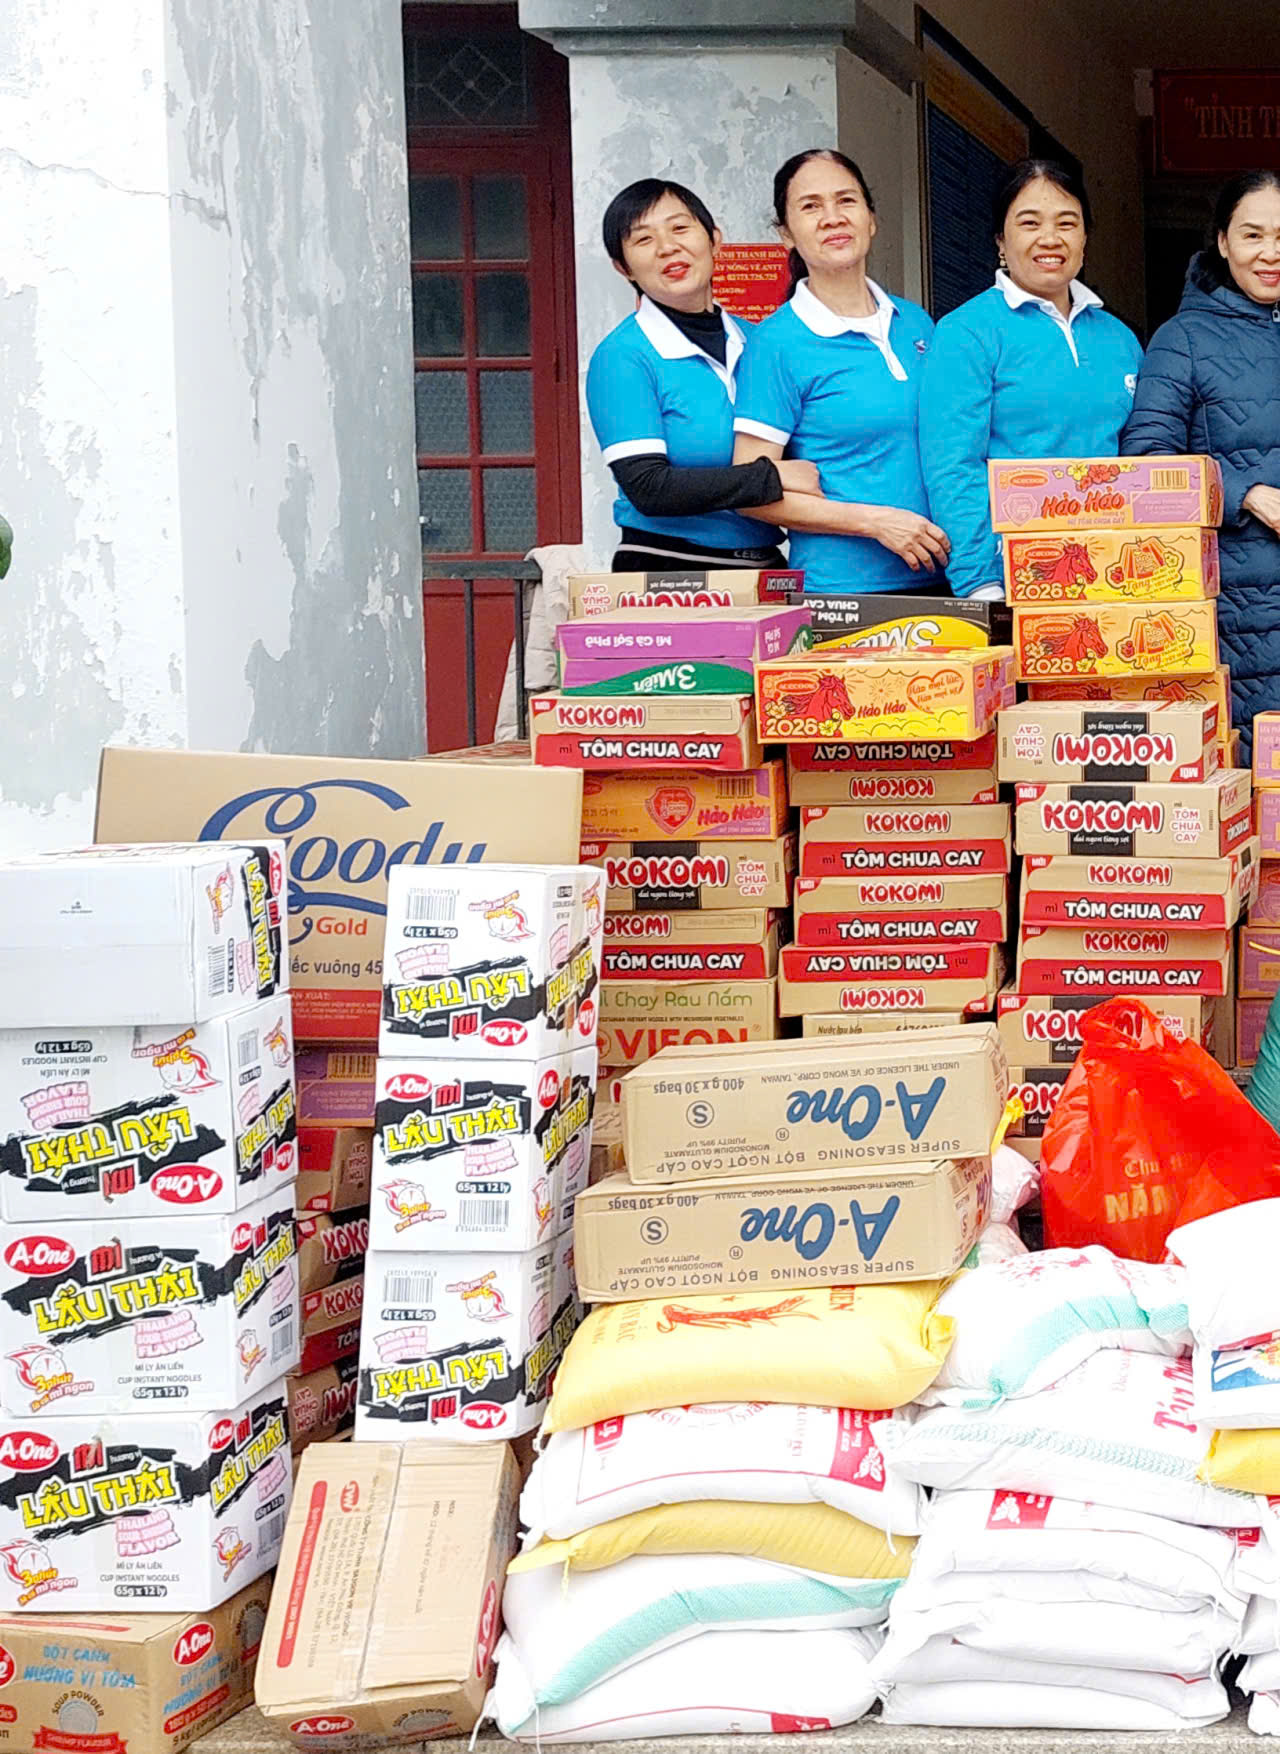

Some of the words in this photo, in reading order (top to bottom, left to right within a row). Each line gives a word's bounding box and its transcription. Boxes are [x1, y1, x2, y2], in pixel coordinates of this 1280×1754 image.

[1016, 583, 1063, 600] 2026
[1026, 658, 1074, 674] 2026
[557, 704, 646, 729] KOKOMI
[766, 718, 818, 736] 2026
[579, 738, 623, 759] TÔM
[625, 743, 680, 758] CHUA
[683, 742, 723, 759] CAY
[1055, 734, 1174, 765] KOKOMI
[851, 777, 935, 799] KOKOMI
[866, 812, 950, 833] KOKOMI
[1043, 803, 1163, 832] KOKOMI
[1175, 809, 1199, 819] TÔM
[1171, 821, 1202, 831] CHUA
[1175, 833, 1198, 843] CAY
[606, 856, 730, 888] KOKOMI
[1089, 864, 1171, 885] KOKOMI
[859, 884, 944, 905] KOKOMI
[316, 916, 368, 937] Gold
[1084, 932, 1168, 953] KOKOMI
[313, 960, 361, 980] vuông
[615, 991, 659, 1011] Chay
[664, 991, 701, 1007] Rau
[841, 988, 925, 1009] KOKOMI
[653, 1079, 683, 1096] bags
[685, 1081, 700, 1094] 30
[702, 1081, 710, 1091] x
[721, 1078, 745, 1092] 400
[786, 1076, 947, 1141] A-One
[818, 1142, 906, 1161] SEASONING
[910, 1139, 961, 1154] SUPER
[655, 1161, 686, 1175] CẤP
[690, 1157, 723, 1170] CAO
[728, 1153, 770, 1167] NGỌT
[776, 1151, 805, 1166] BỘT
[740, 1195, 900, 1261] A-One
[9, 1241, 71, 1266] A-One
[111, 1264, 199, 1310] THÁI
[93, 1463, 177, 1511] THÁI
